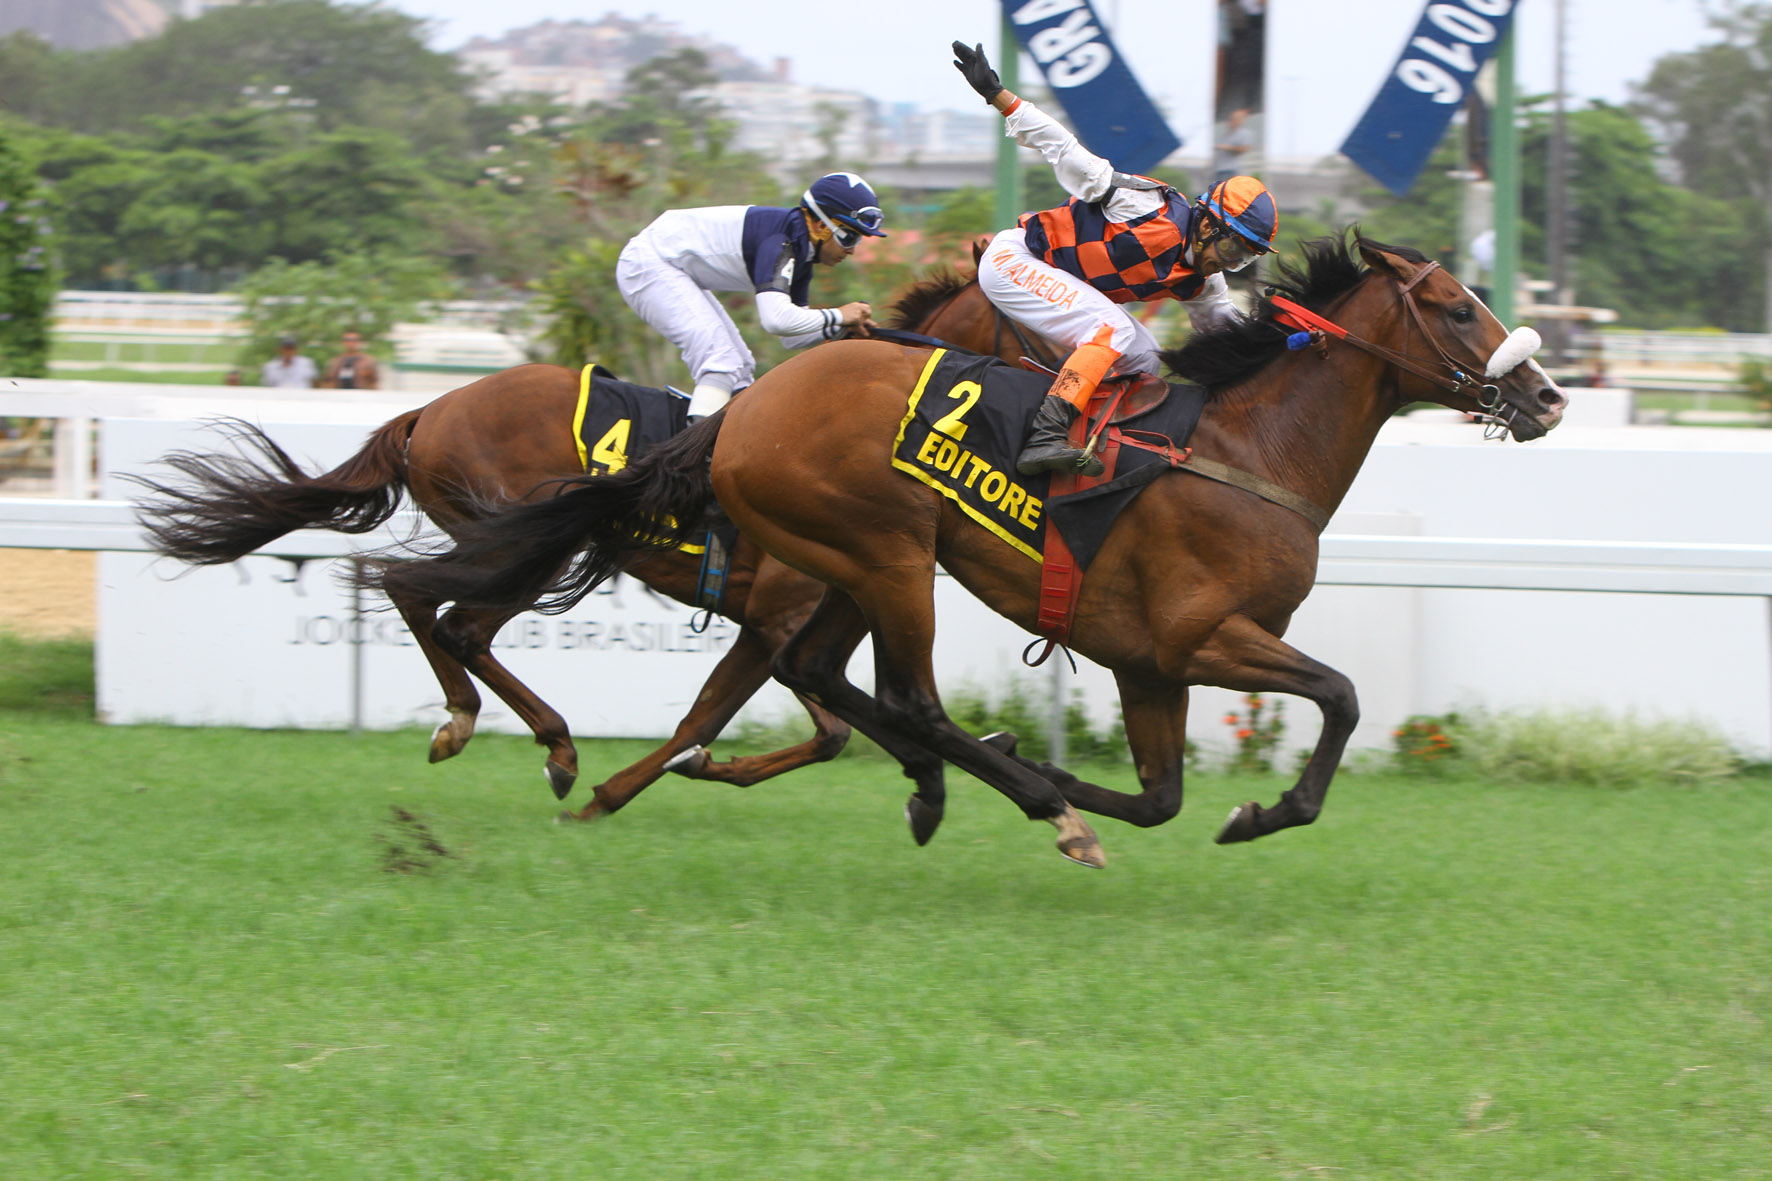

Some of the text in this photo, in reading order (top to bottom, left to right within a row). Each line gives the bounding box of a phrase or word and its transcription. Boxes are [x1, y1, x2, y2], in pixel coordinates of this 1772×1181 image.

[932, 380, 982, 441] 2
[591, 418, 632, 475] 4
[916, 431, 1043, 531] EDITORE
[288, 616, 416, 646] JOCKE
[557, 620, 738, 653] BRASILEIR
